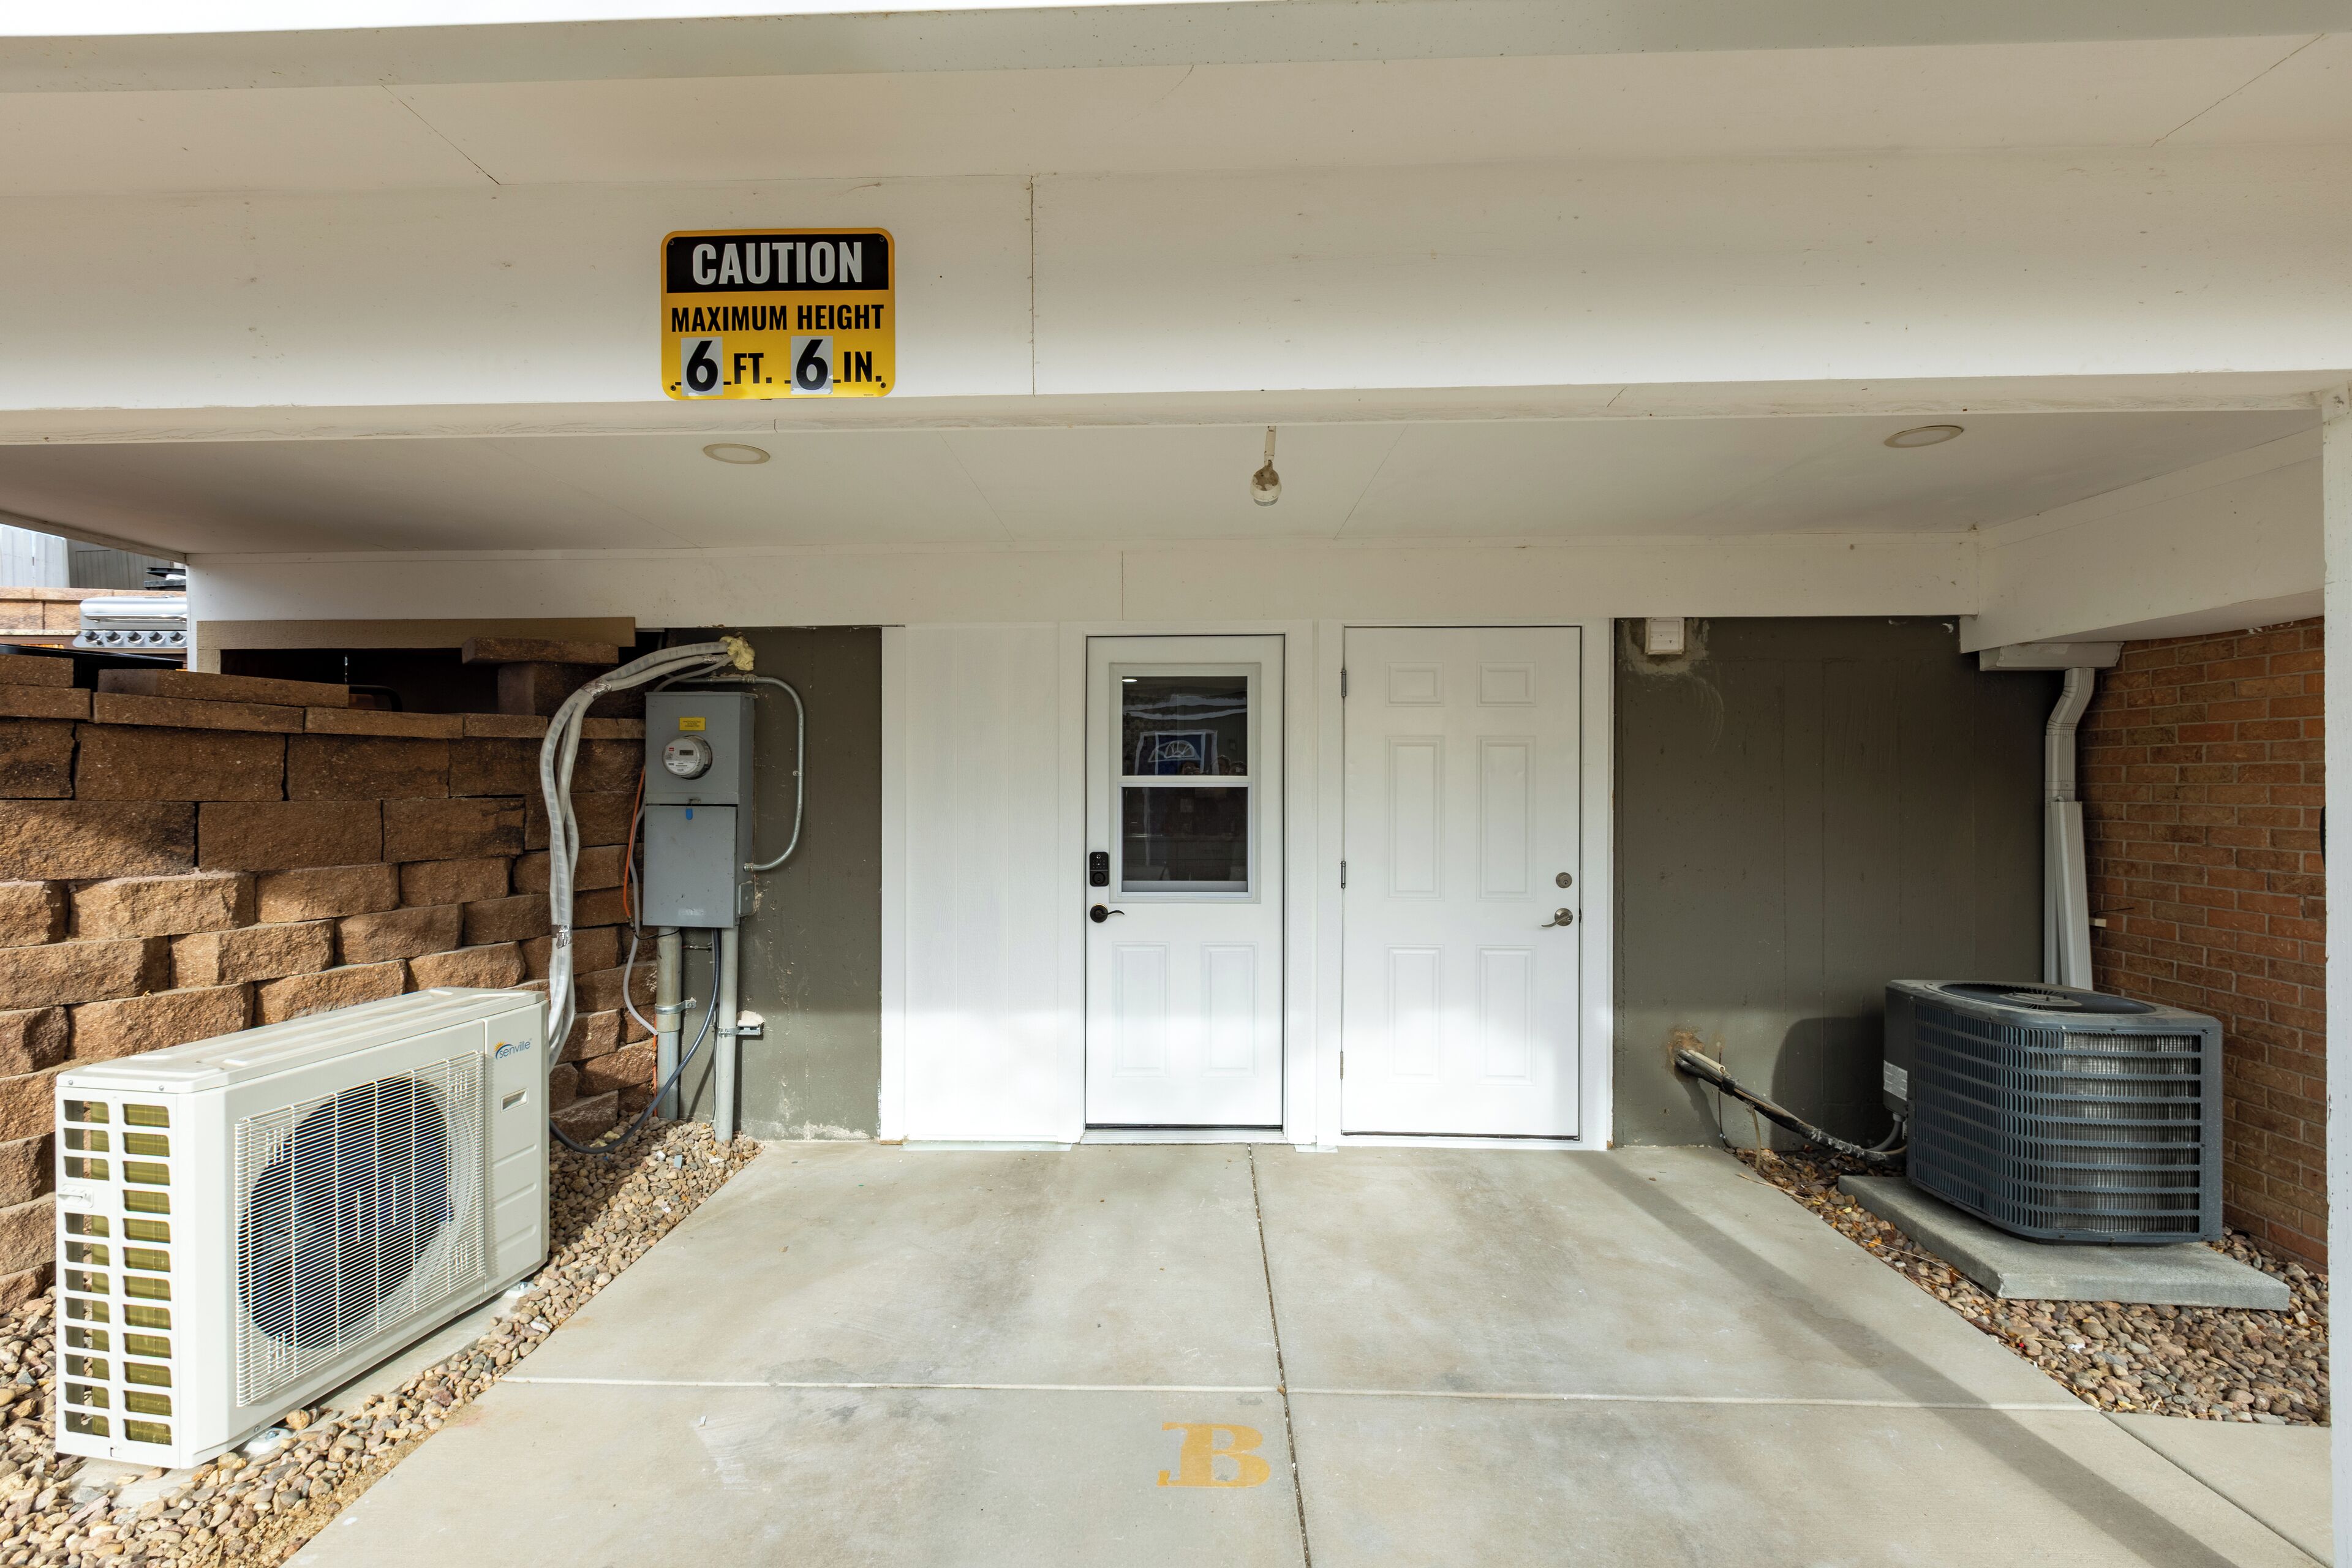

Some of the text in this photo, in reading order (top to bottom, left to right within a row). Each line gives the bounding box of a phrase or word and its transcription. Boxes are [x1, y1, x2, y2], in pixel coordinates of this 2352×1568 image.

[692, 241, 862, 285] CAUTION
[671, 304, 884, 333] MAXIMUM HEIGHT
[686, 339, 882, 392] 6 FT. 6 IN.
[499, 1041, 530, 1058] senville
[1156, 1422, 1271, 1488] B
